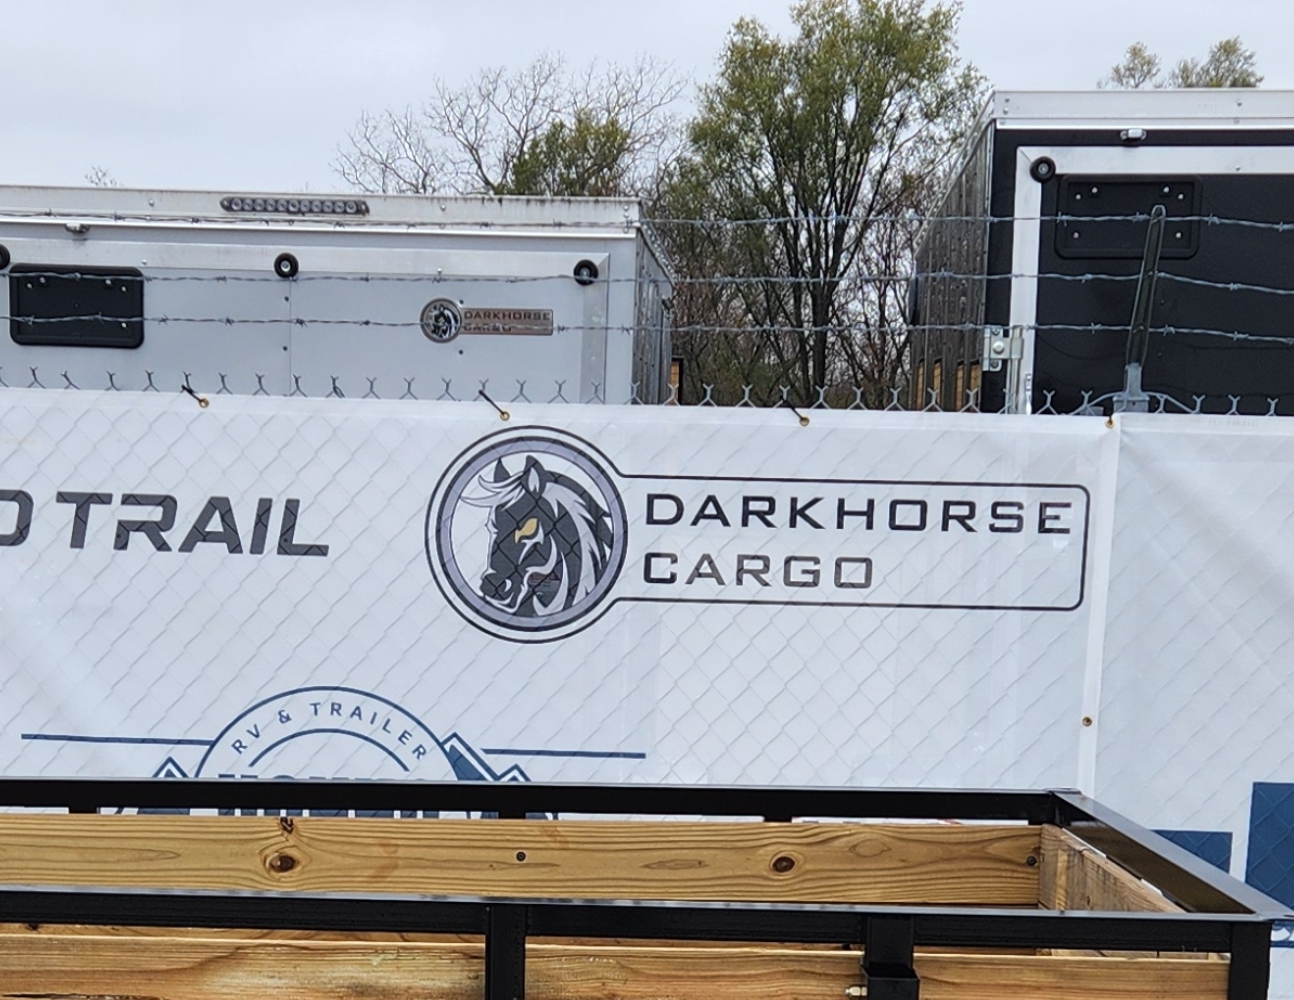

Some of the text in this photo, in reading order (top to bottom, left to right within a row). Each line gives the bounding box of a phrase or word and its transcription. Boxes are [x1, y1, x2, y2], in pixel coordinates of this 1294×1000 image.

[463, 310, 551, 321] DARKHORSE
[56, 491, 329, 556] TRAIL
[645, 493, 1073, 534] DARKHORSE
[643, 552, 874, 589] CARGO
[231, 702, 428, 760] RV & TRAILER
